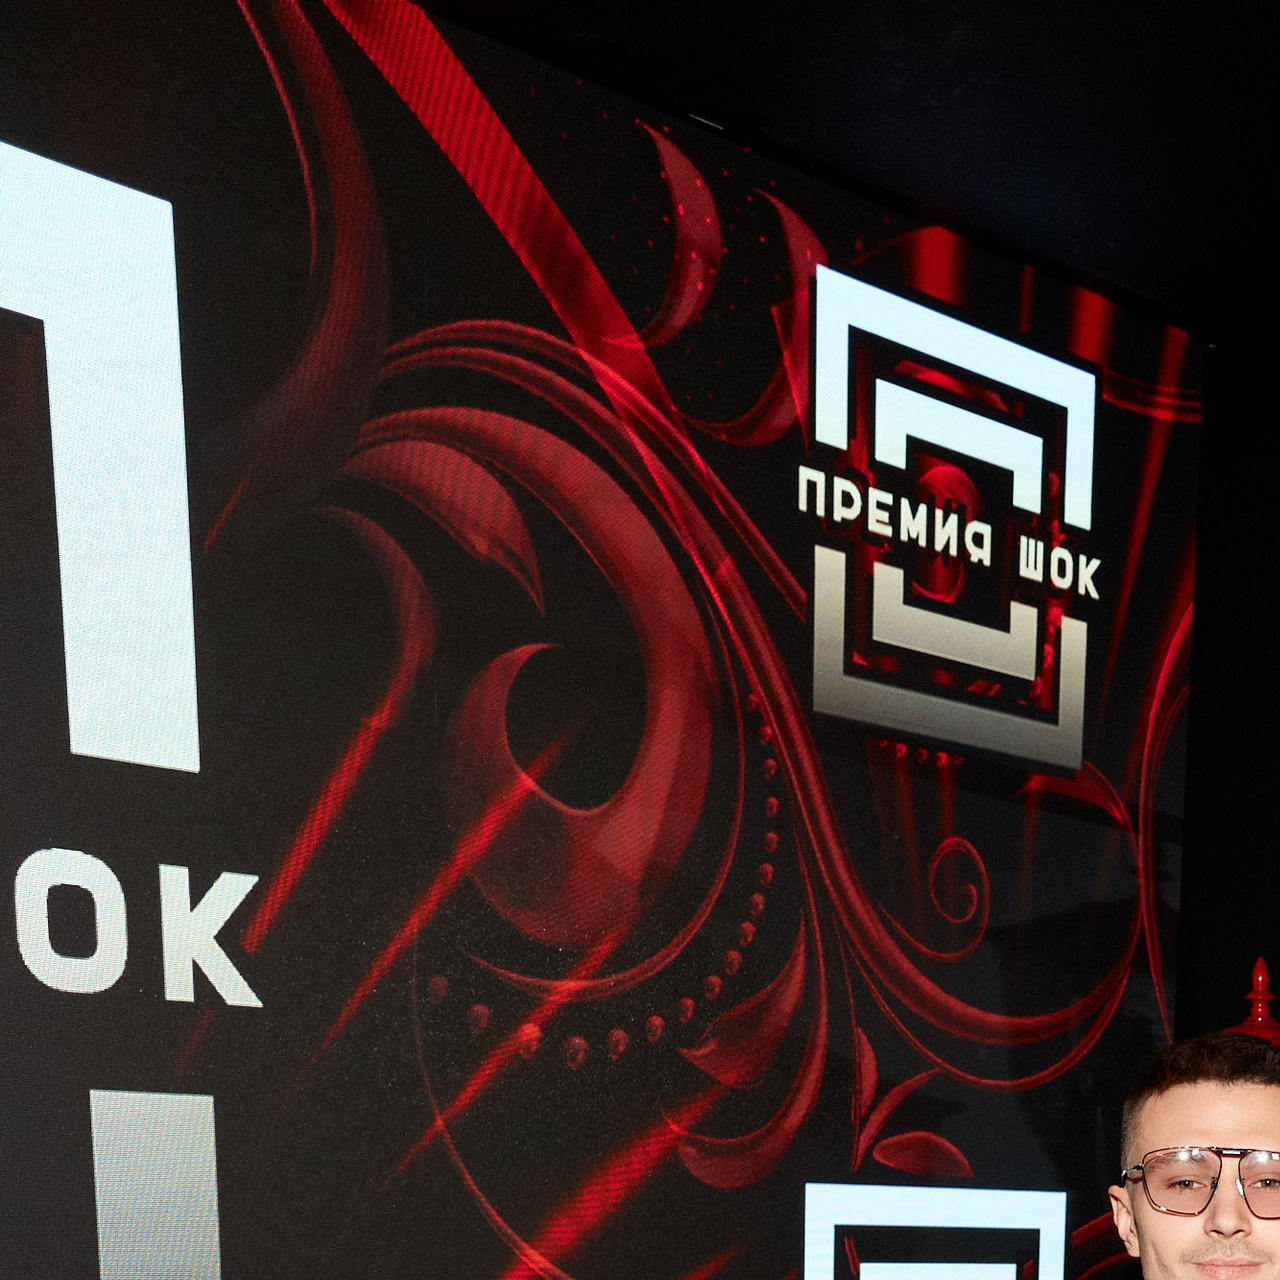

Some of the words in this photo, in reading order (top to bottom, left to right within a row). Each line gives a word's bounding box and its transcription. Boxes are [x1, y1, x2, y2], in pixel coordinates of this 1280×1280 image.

[798, 464, 992, 568] ПРЕМИЯ
[1018, 534, 1101, 600] ШОК
[13, 847, 264, 1008] ОК
